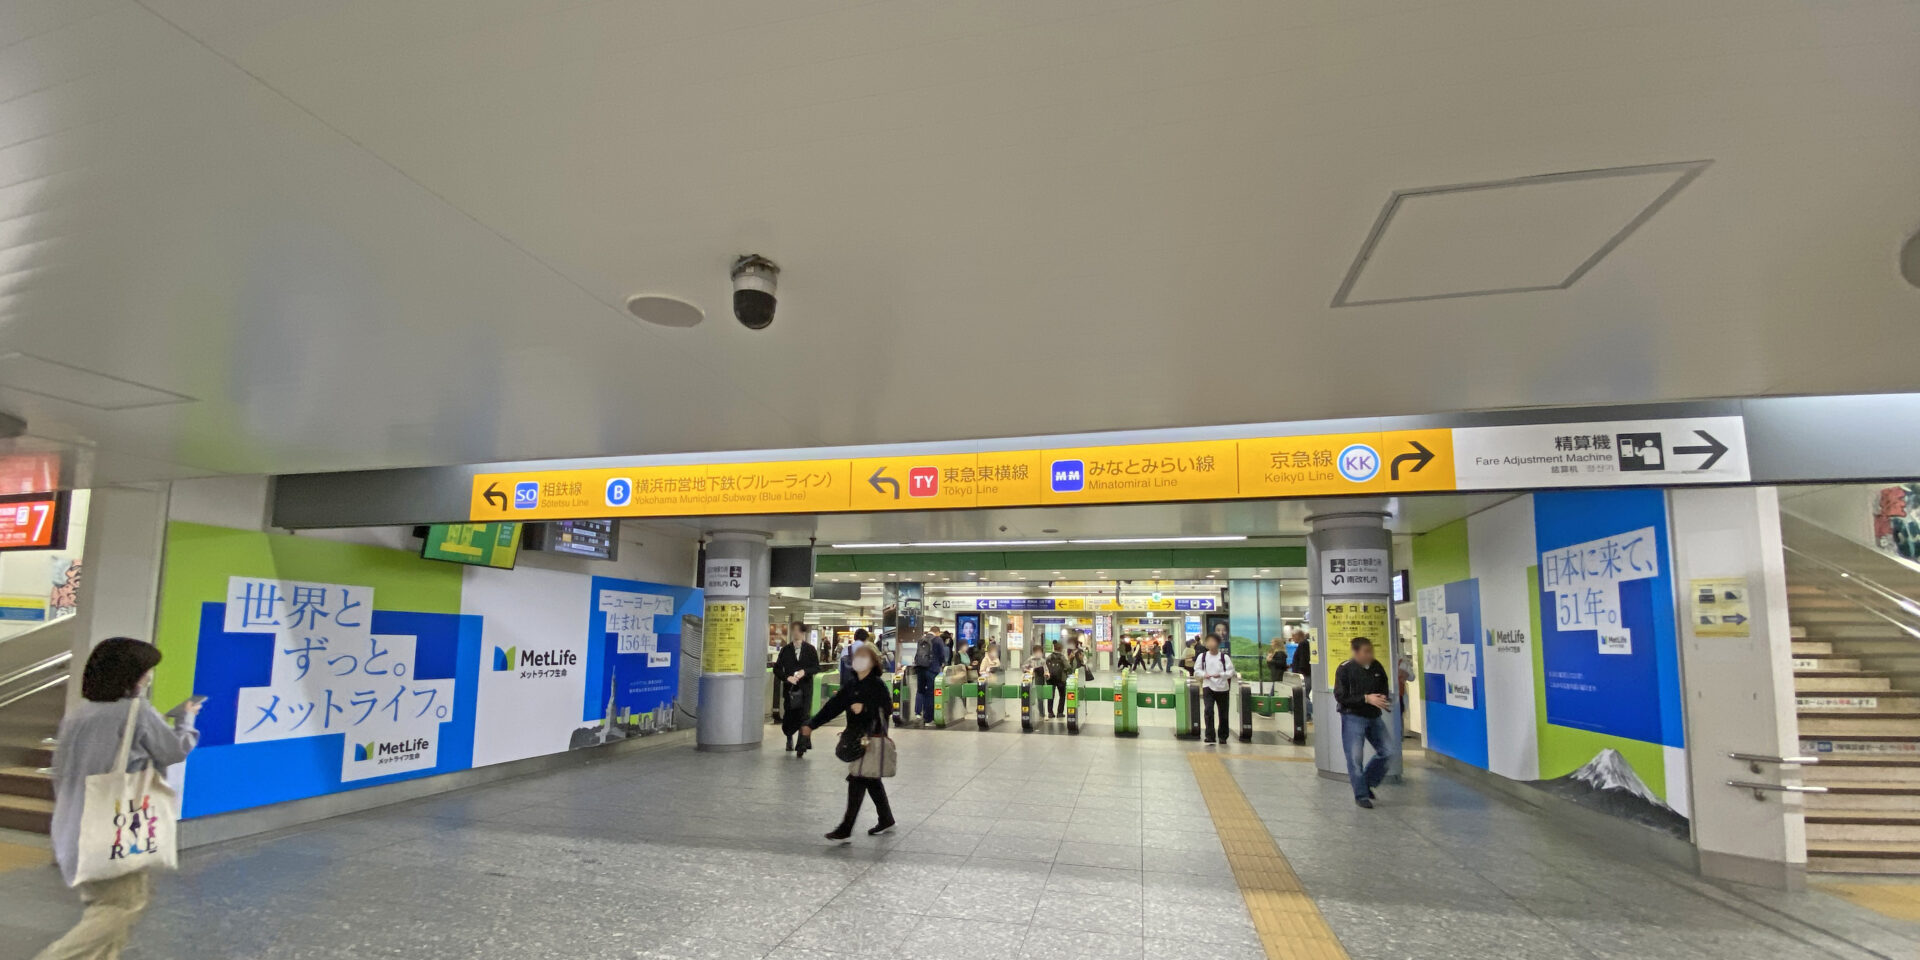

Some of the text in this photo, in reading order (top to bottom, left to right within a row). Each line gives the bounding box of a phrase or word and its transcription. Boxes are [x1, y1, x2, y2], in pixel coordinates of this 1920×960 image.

[1555, 435, 1611, 451] 精算機
[1089, 455, 1215, 476] みなとみらい線
[1270, 449, 1333, 469] 京急線
[1345, 455, 1372, 470] KK
[1476, 453, 1613, 467] Fare Adjustment Machine
[913, 475, 935, 489] TY
[943, 464, 1029, 484] 東急東横線
[1308, 471, 1335, 481] Line
[543, 481, 583, 497] 相鉄線
[976, 484, 998, 494] Line
[1088, 477, 1178, 490] Minatomirai Line
[516, 488, 537, 502] SO
[613, 485, 625, 500] B
[635, 490, 807, 505] Yokohama Municipal Subway (Blue Line)
[572, 499, 590, 507] Line
[32, 504, 50, 541] 7
[1546, 537, 1653, 587] 日本に来て、
[1347, 575, 1378, 583] 南改札内
[236, 582, 362, 631] 世界と
[1560, 587, 1617, 626] 51年。
[608, 613, 653, 632] 生まれて
[620, 633, 657, 652] 156年。
[1497, 629, 1525, 644] MetLife
[284, 636, 406, 682] ずっと。
[520, 649, 577, 667] MetLife
[520, 668, 568, 679] メットライフ生命
[243, 685, 448, 734] メットライフ。
[378, 738, 430, 756] MetLife
[378, 753, 421, 765] メットライフ生命
